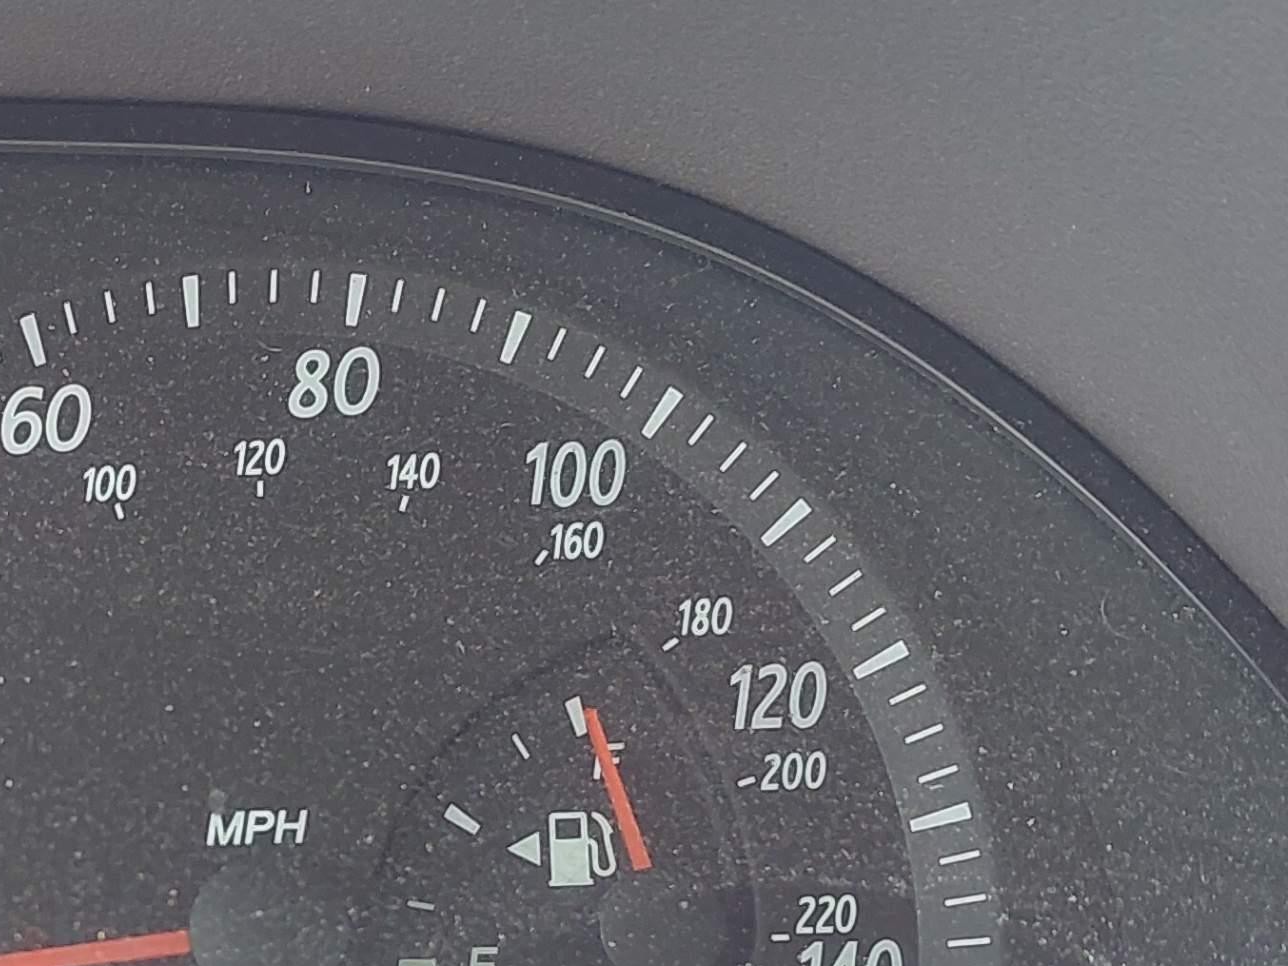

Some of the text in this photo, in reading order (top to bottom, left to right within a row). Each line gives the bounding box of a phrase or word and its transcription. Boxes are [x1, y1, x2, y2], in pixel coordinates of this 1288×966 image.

[288, 347, 381, 418] 80
[0, 384, 92, 455] 60
[234, 439, 285, 475] 120
[387, 452, 440, 490] 140
[526, 439, 626, 507] 100
[83, 464, 136, 502] 100
[549, 521, 604, 560] 160
[678, 597, 732, 635] 180
[729, 661, 827, 730] 120
[760, 752, 827, 791] 200
[206, 809, 308, 846] MPH
[795, 895, 857, 934] 220
